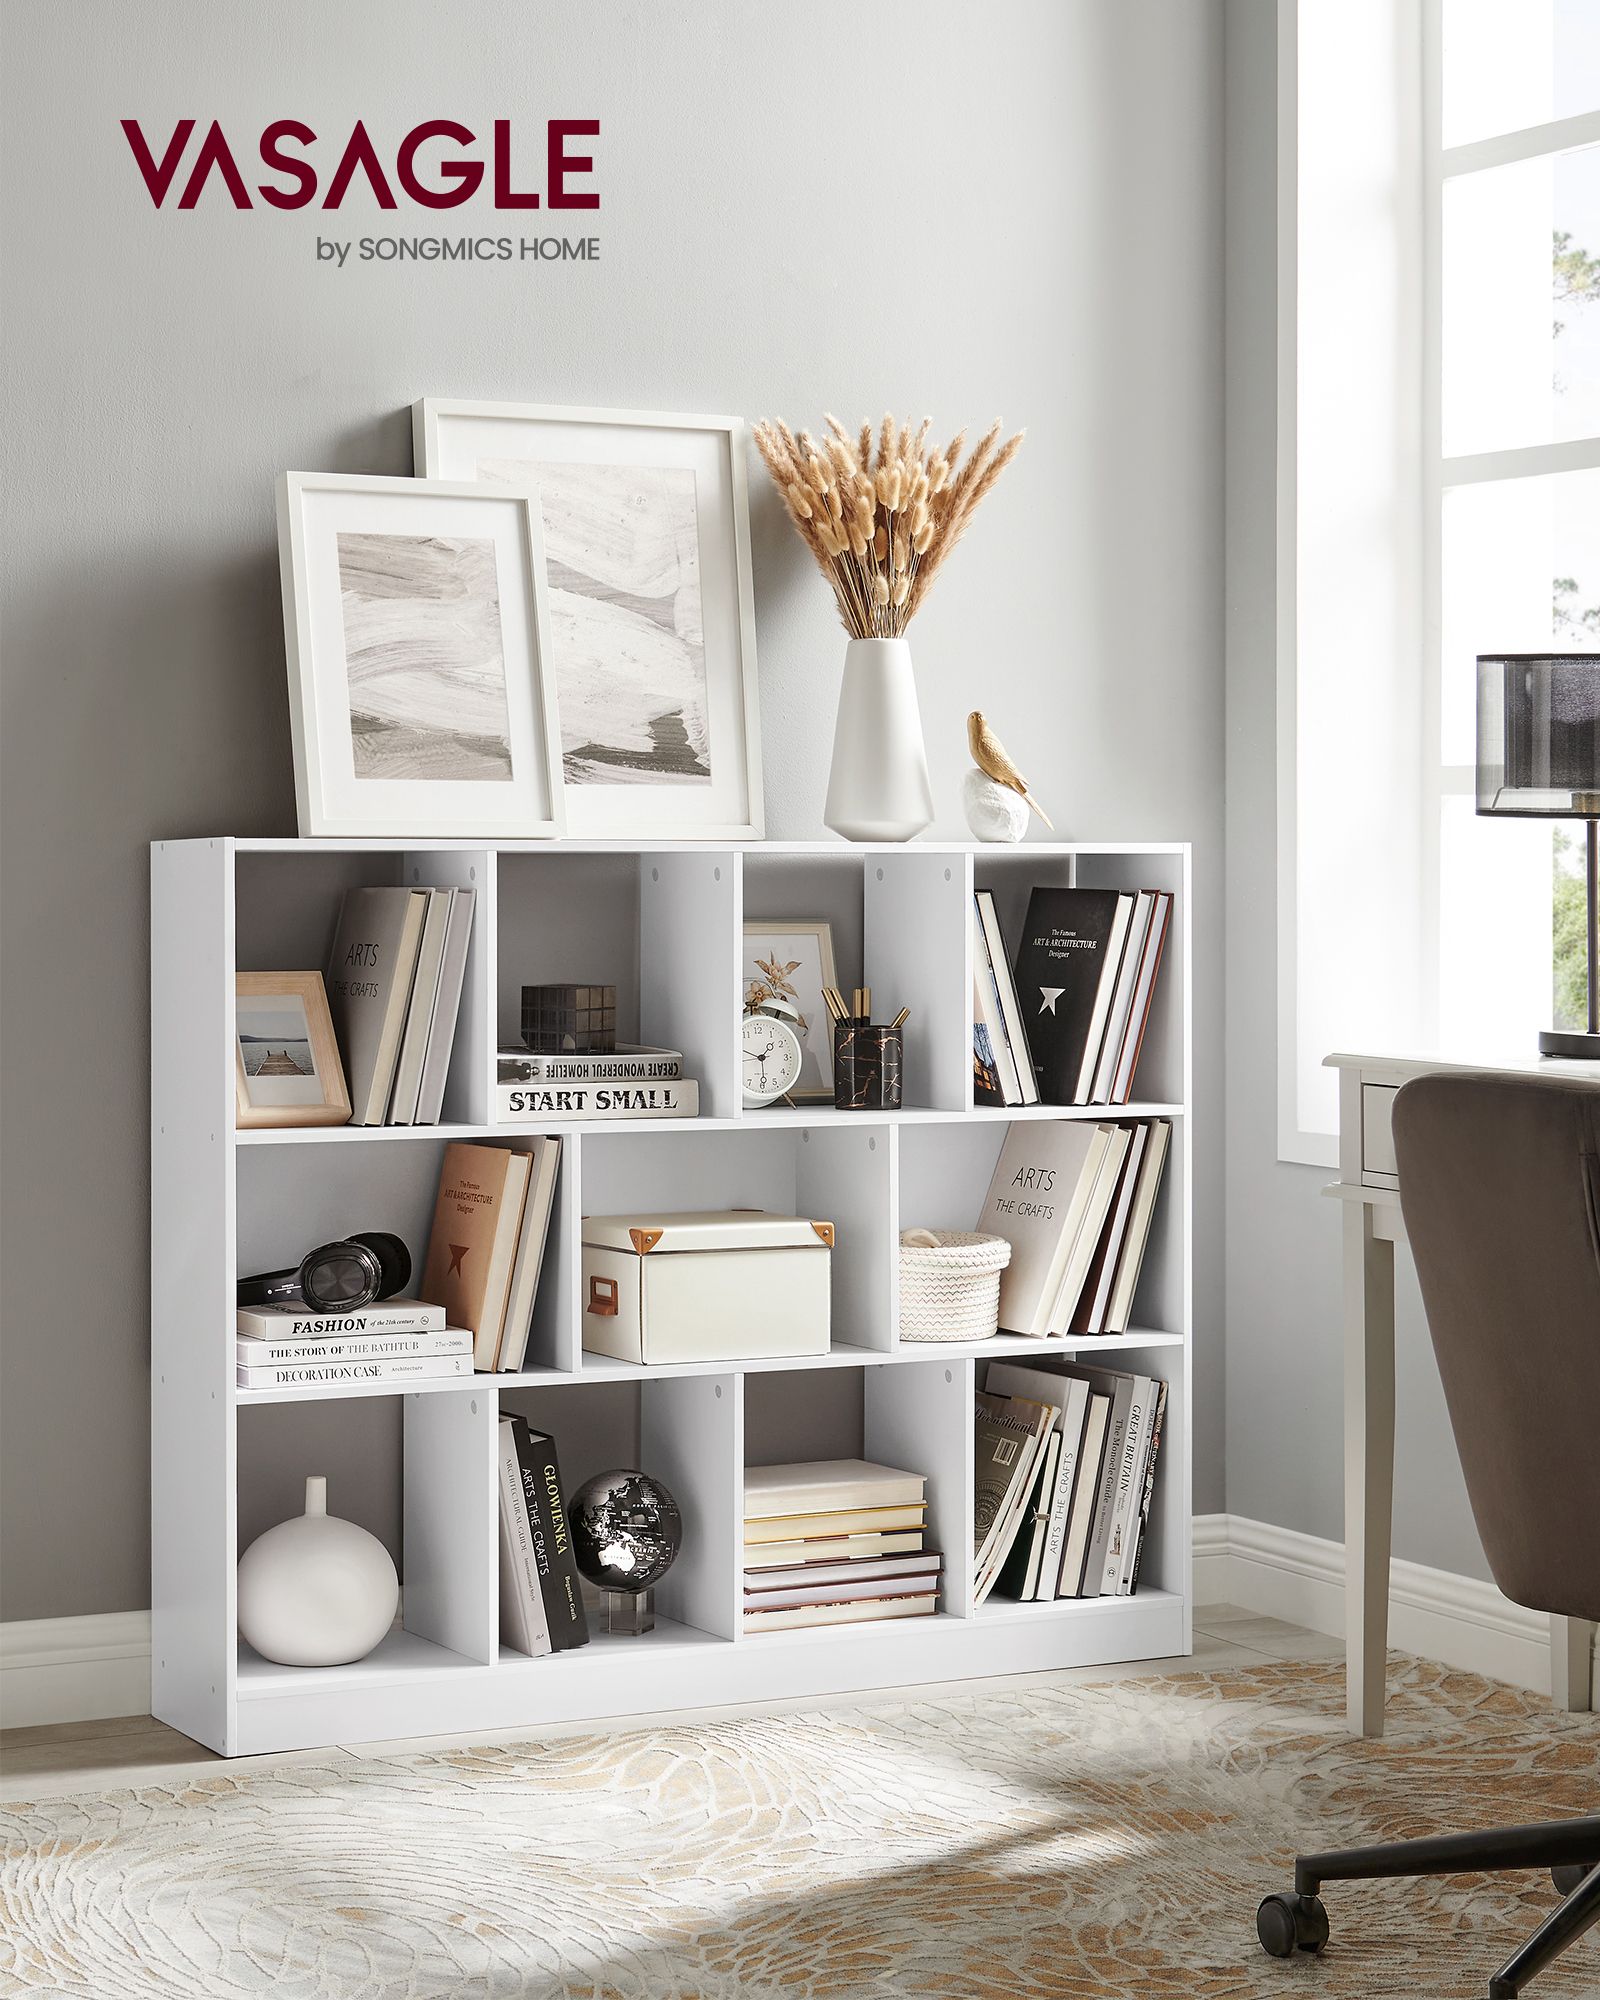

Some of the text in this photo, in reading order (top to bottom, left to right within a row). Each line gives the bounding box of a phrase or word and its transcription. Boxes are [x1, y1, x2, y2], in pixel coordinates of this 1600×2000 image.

[1050, 939, 1098, 949] ARCHITECTURE
[345, 943, 379, 967] ARTS
[350, 981, 379, 998] CRAFTS
[754, 1026, 763, 1035] 12
[778, 1040, 784, 1048] 2
[783, 1053, 789, 1061] 3
[545, 1062, 679, 1078] CREATE WONDERFUL HOMELIFE
[780, 1068, 786, 1076] 4
[772, 1078, 778, 1086] 5
[509, 1089, 679, 1112] START SMALL
[1011, 1166, 1057, 1192] ARTS
[995, 1198, 1055, 1220] THE CRAFTS
[292, 1318, 367, 1334] FASHION
[269, 1348, 292, 1358] THE
[294, 1346, 328, 1357] STORY
[330, 1344, 345, 1354] OF
[347, 1343, 369, 1354] THE
[371, 1341, 419, 1353] BATHTUB
[276, 1367, 352, 1383] DECORATION
[353, 1364, 382, 1379] CASE
[1115, 1418, 1124, 1436] The
[1127, 1404, 1142, 1443] GREAT
[1107, 1437, 1121, 1476] Monocle
[1120, 1444, 1135, 1492] BRITAIN
[1103, 1476, 1115, 1504] Guide
[505, 1457, 522, 1527] ARCHITECTURAL
[517, 1526, 528, 1553] GUIDE
[543, 1464, 568, 1555] GŁOWIENKA
[1049, 1452, 1074, 1555] ARTS THE CRAFTS
[521, 1467, 550, 1576] ARTS THE CRAFTS
